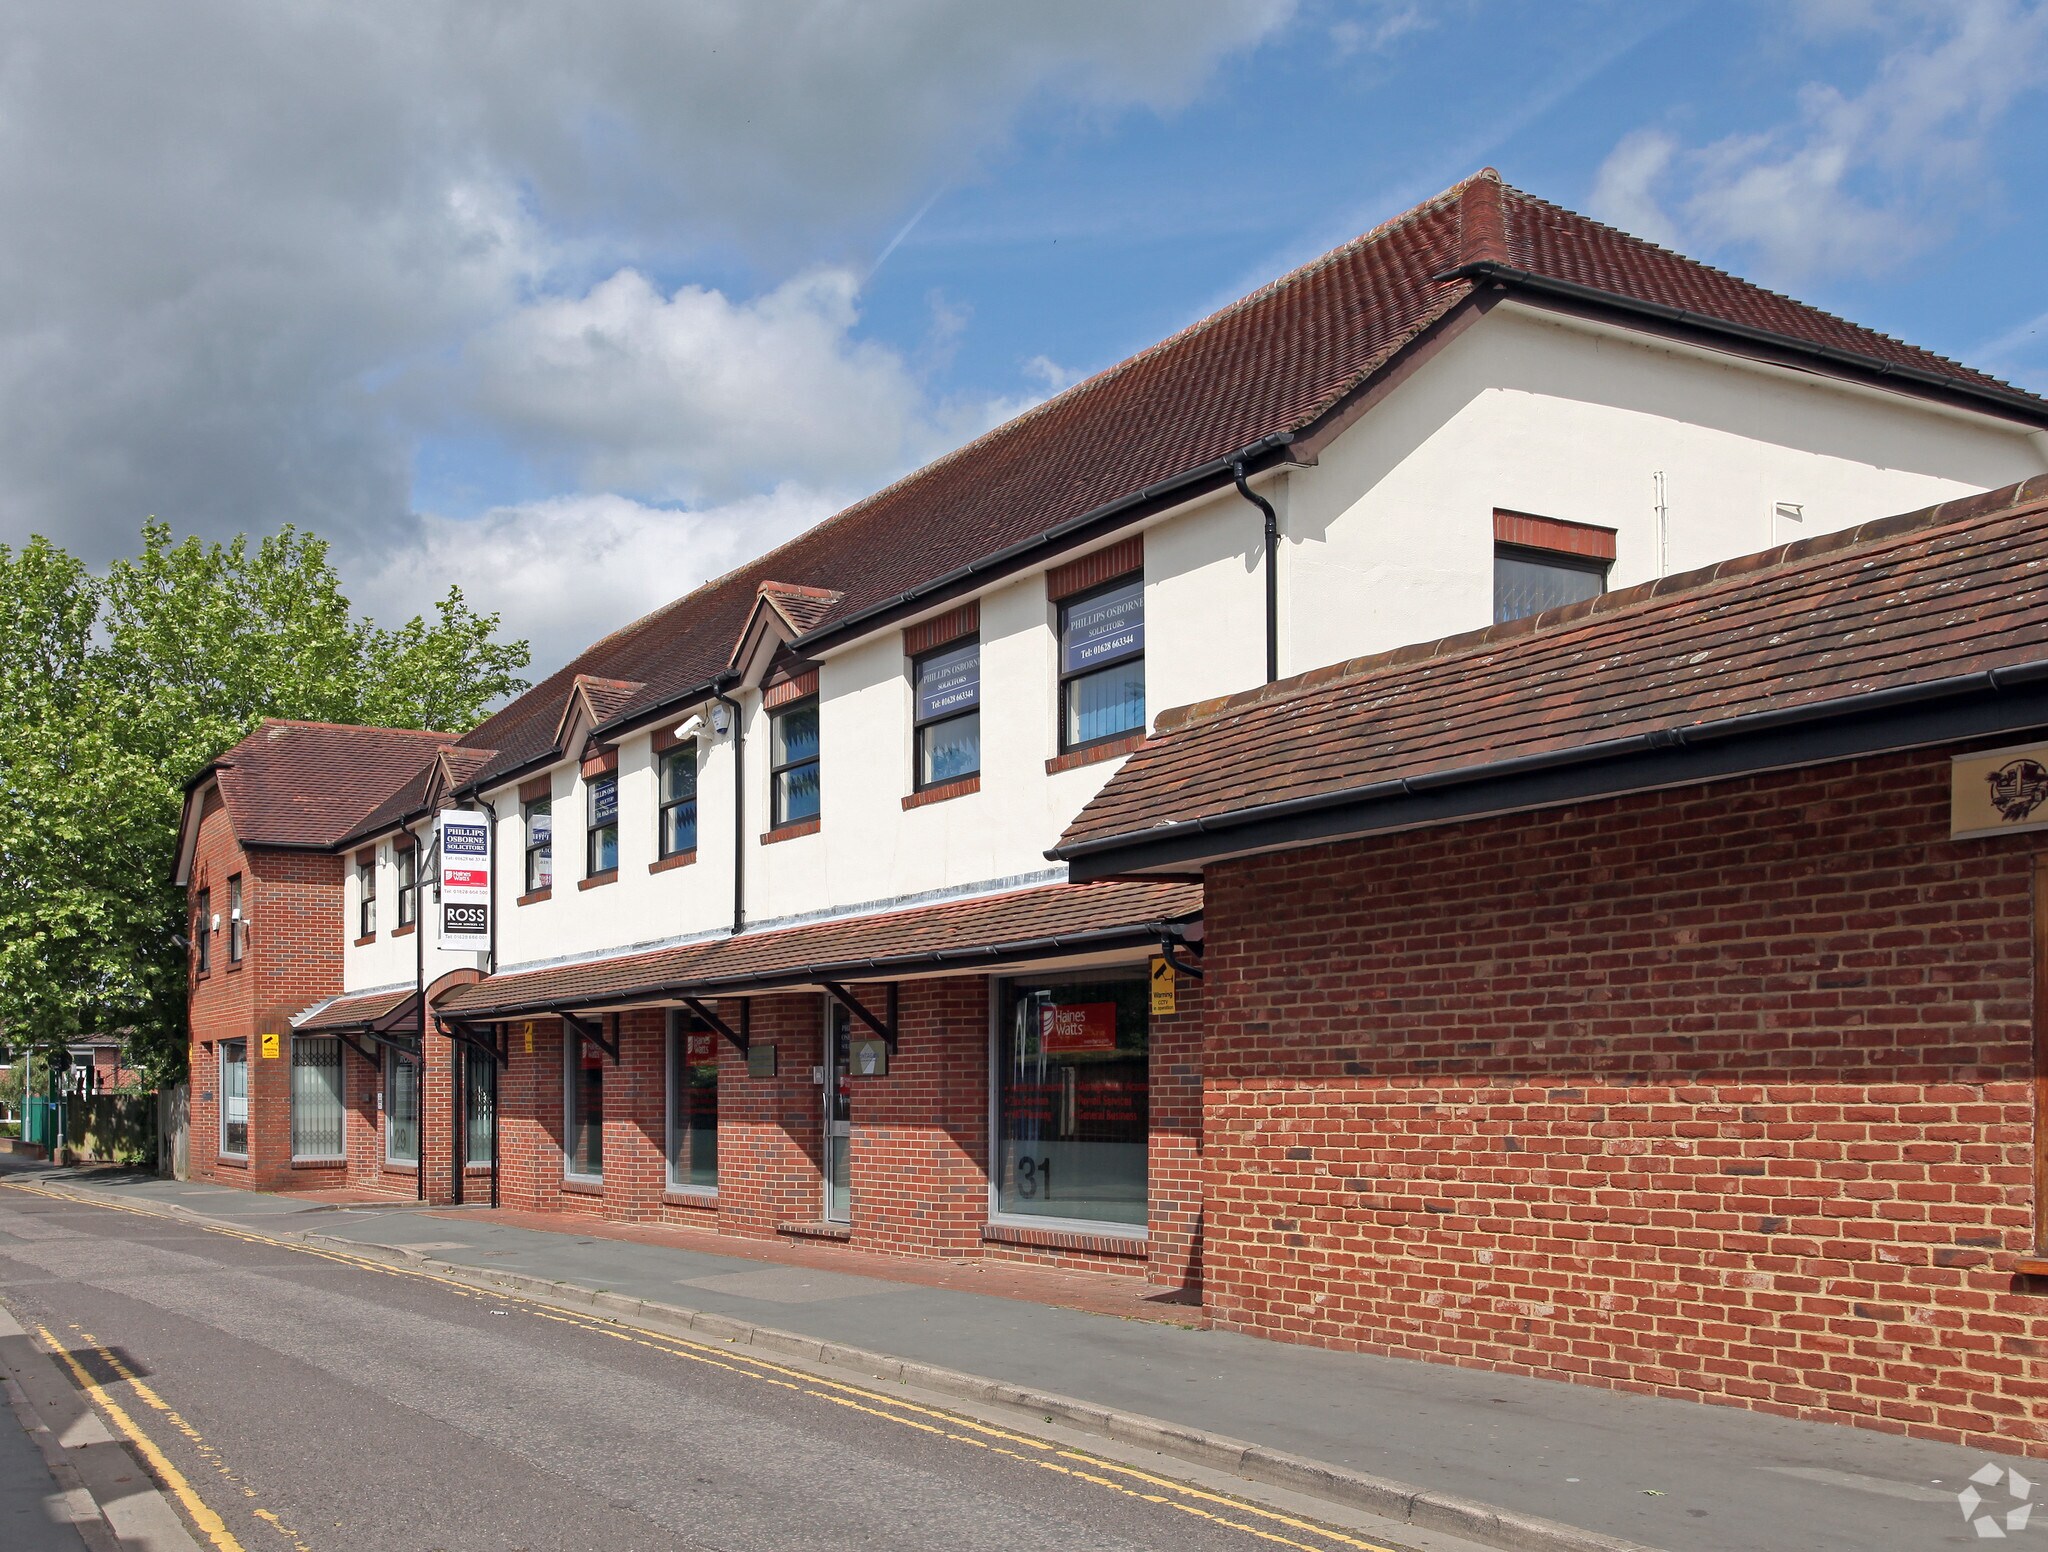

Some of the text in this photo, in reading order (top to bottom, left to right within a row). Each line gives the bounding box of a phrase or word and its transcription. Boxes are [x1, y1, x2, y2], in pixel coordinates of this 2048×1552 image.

[1070, 610, 1106, 632] PHILLIPS
[1088, 618, 1125, 637] SOLICITORS
[1080, 634, 1134, 659] Tel: 01628 663344
[923, 668, 951, 684] PHILLIPS
[447, 828, 485, 836] PHILLIPS
[447, 836, 485, 844] OSBORNE
[447, 843, 485, 851] SOLICITORS
[447, 908, 485, 922] ROSS
[1055, 1010, 1086, 1023] Haines
[1056, 1023, 1083, 1036] Watts
[1106, 1109, 1137, 1120] Business
[395, 1128, 406, 1150] 29
[1018, 1156, 1050, 1200] 31
